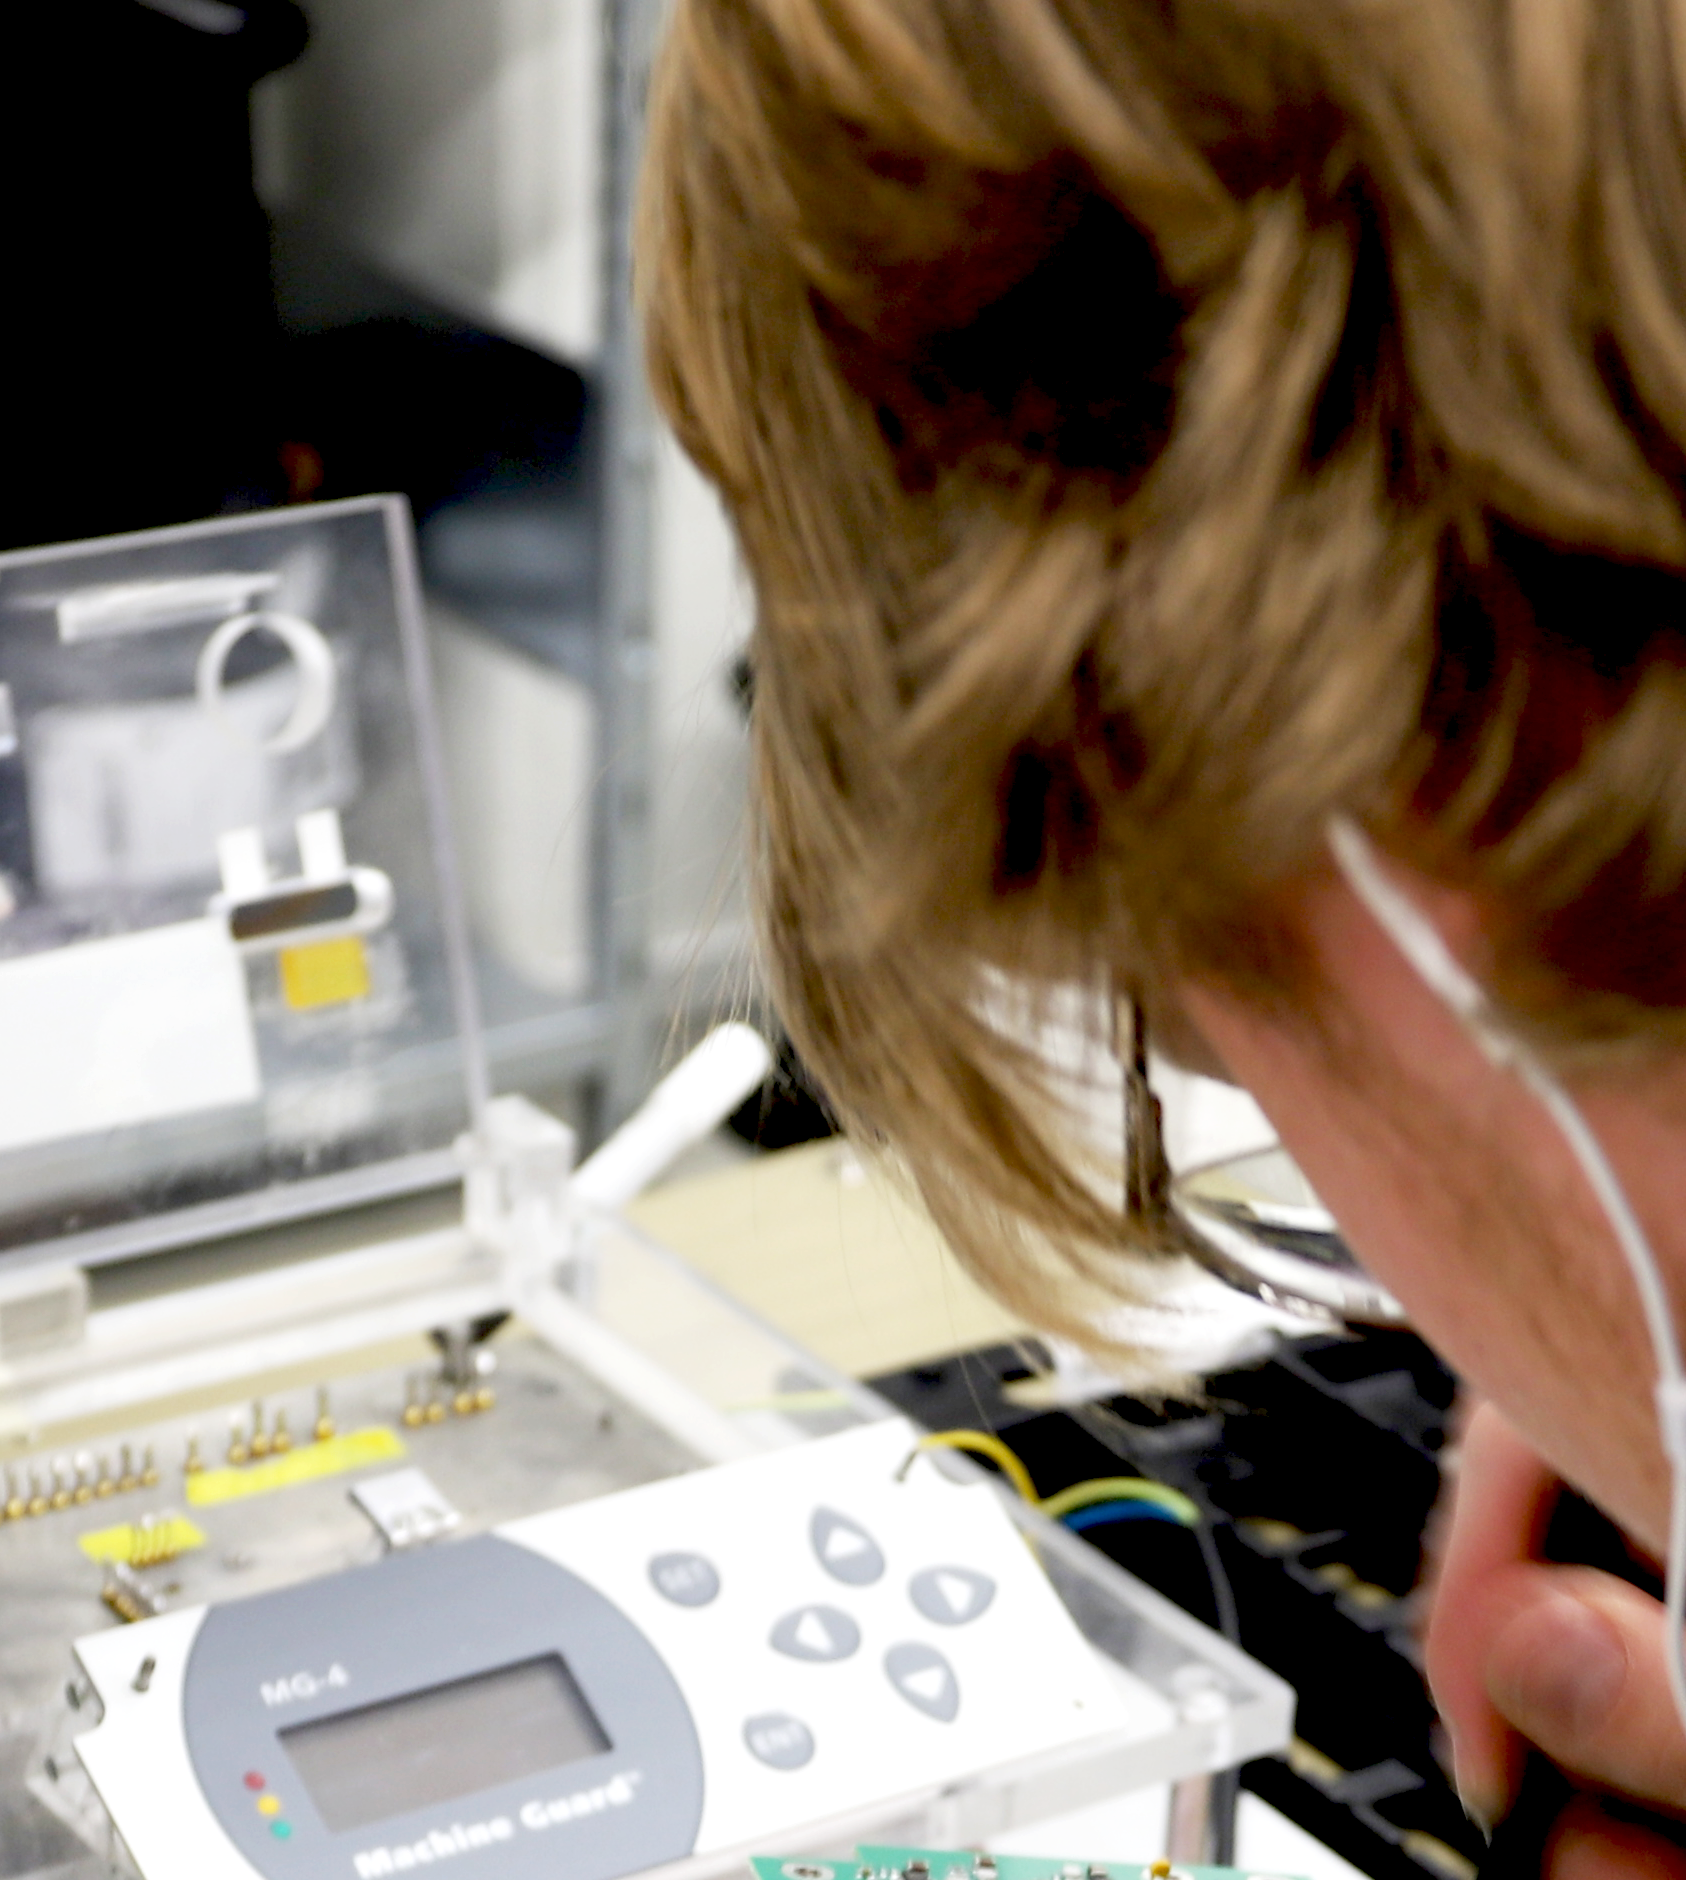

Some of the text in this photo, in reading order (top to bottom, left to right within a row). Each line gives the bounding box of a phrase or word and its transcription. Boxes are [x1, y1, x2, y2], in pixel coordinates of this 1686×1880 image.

[260, 1662, 350, 1708] MG-4
[354, 1779, 635, 1880] Machine Guard
